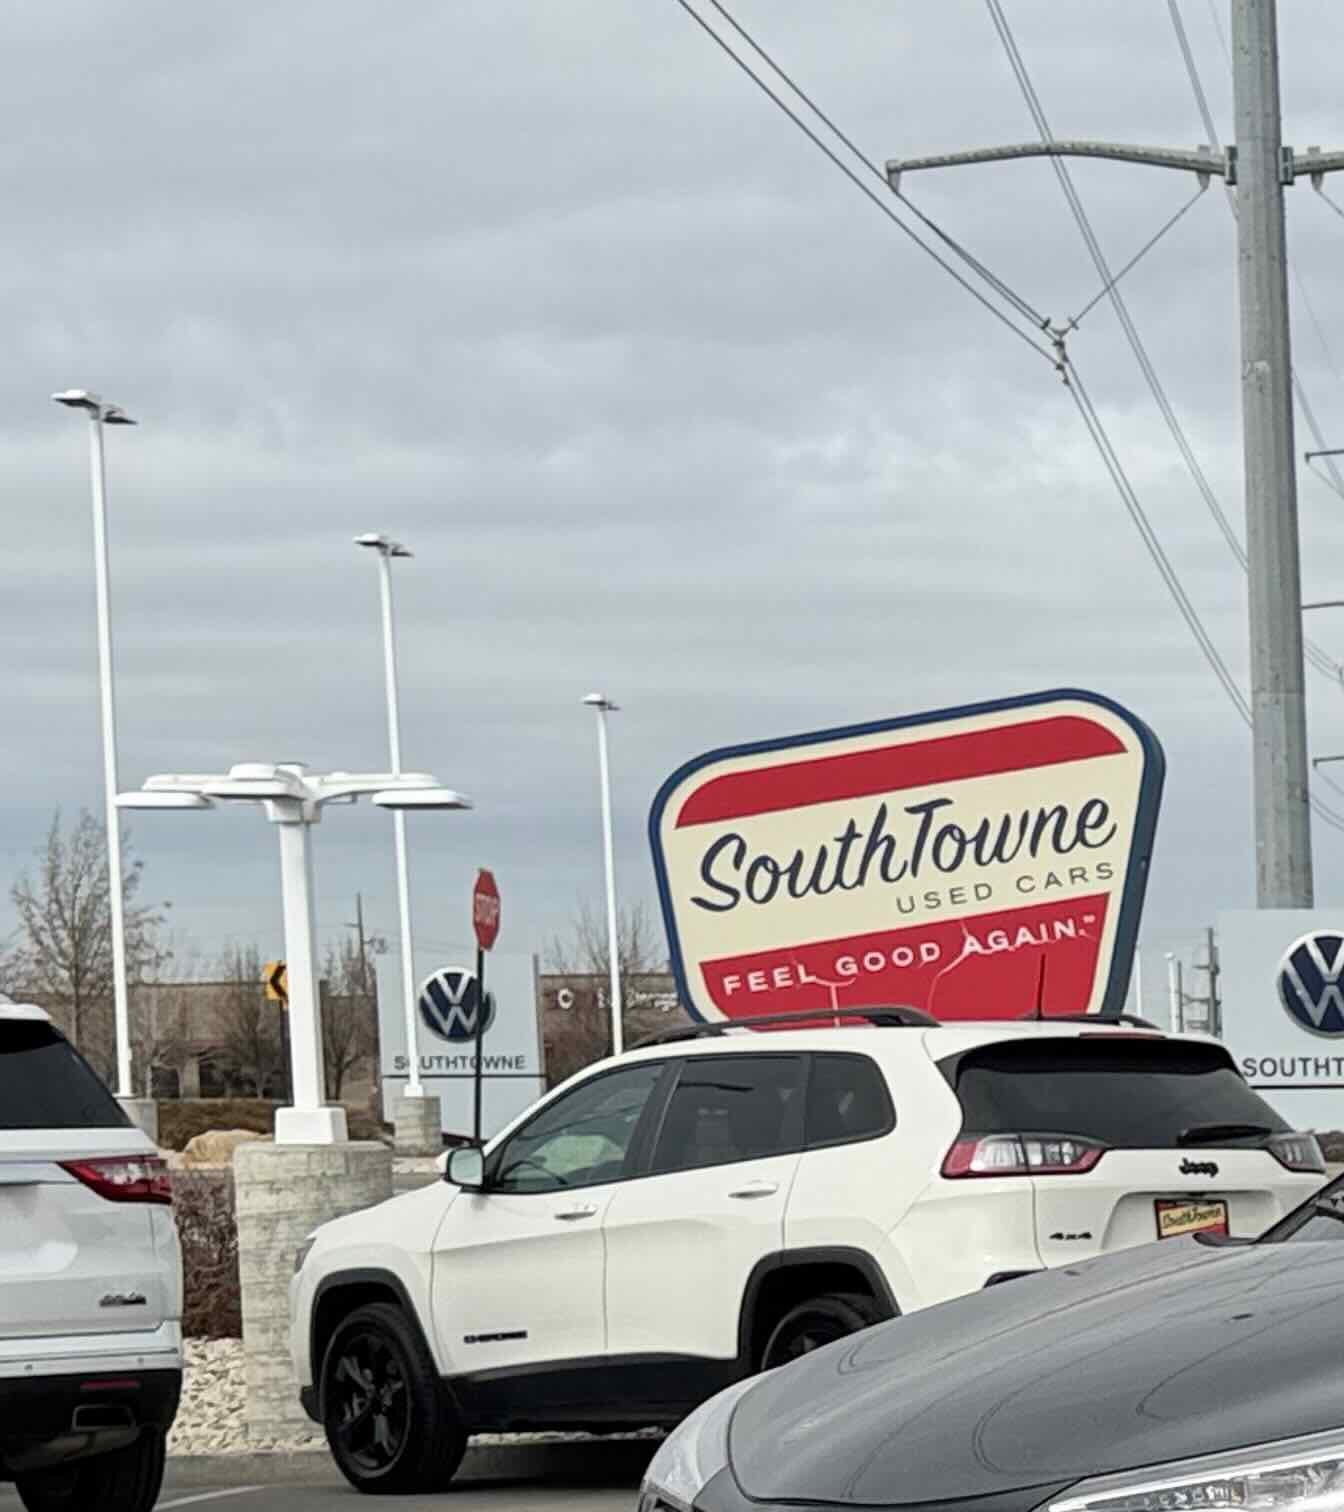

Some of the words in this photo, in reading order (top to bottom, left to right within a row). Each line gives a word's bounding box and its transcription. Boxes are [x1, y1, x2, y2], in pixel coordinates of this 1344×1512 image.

[896, 882, 993, 914] USED
[1015, 861, 1114, 894] CARS
[722, 962, 817, 996] FEEL
[835, 941, 942, 977] GOOD
[393, 1055, 528, 1071] SUTHTOWNE
